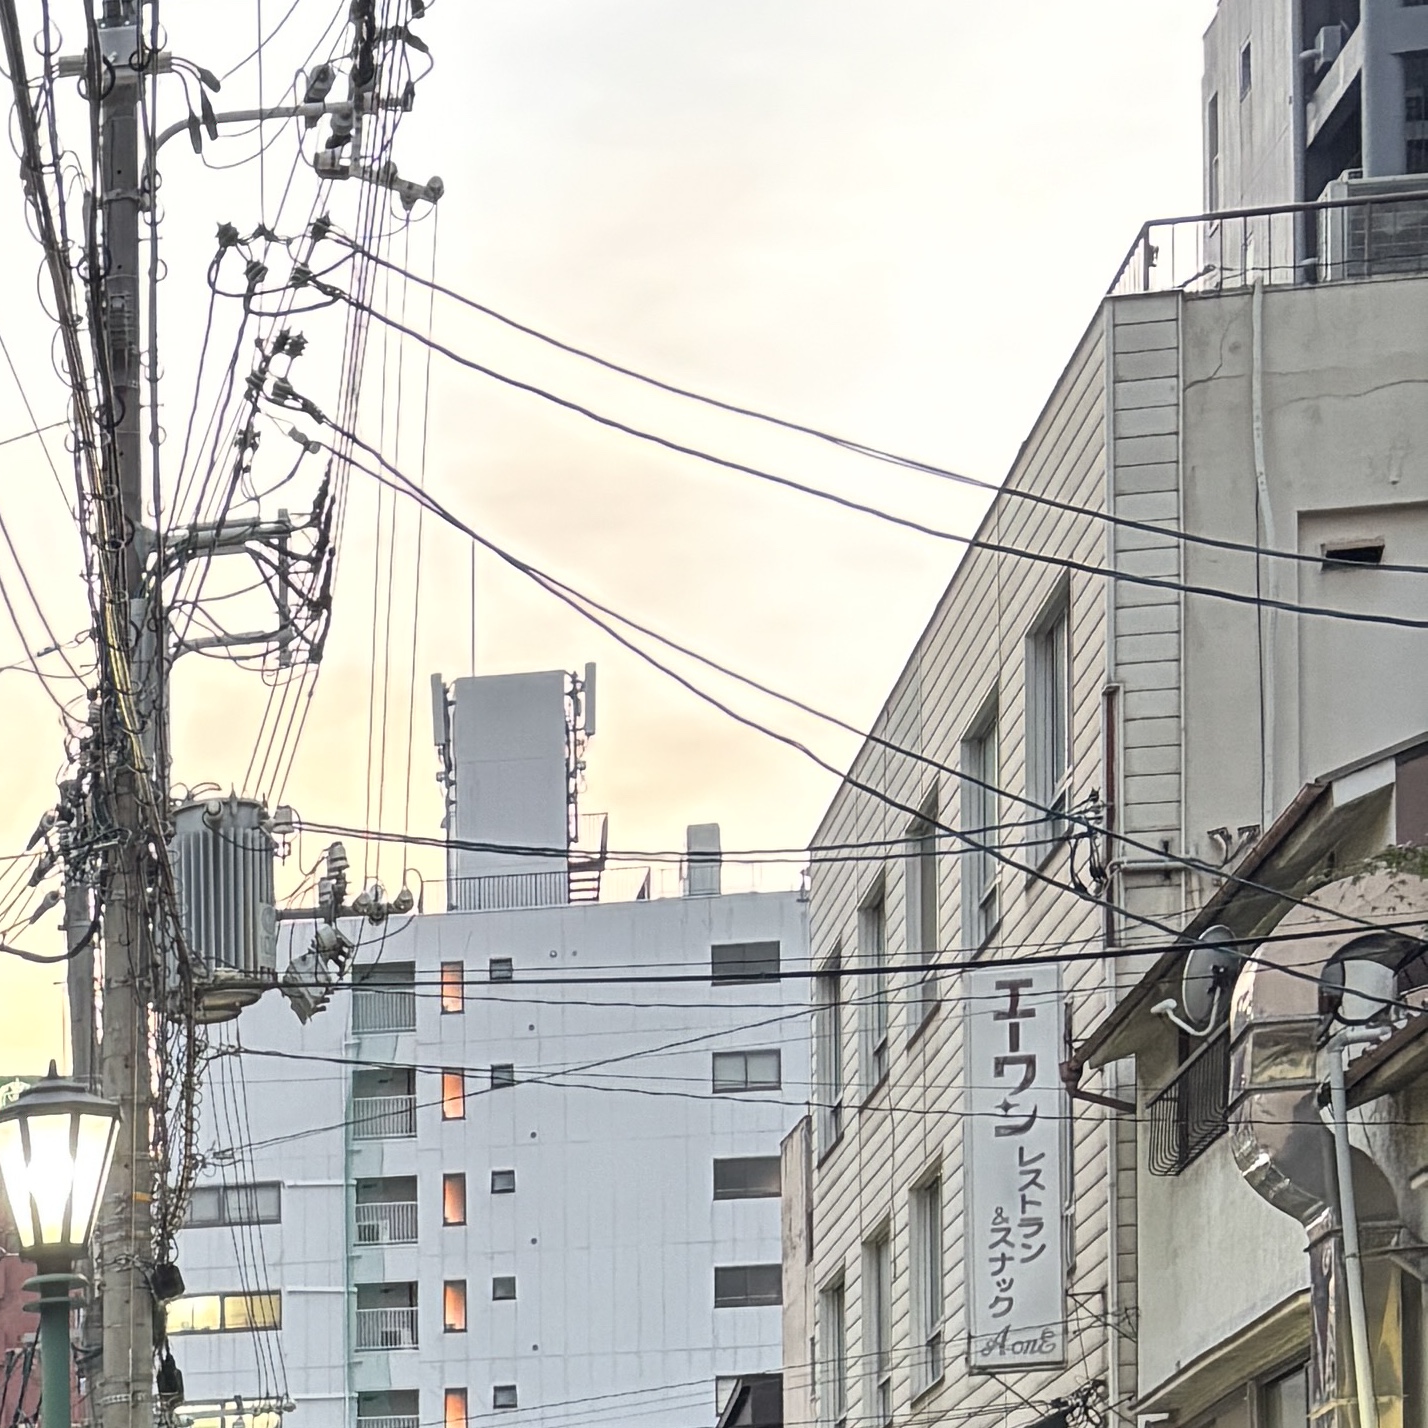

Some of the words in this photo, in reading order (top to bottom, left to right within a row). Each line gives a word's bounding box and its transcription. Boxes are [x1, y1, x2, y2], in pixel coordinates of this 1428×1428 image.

[993, 978, 1038, 1137] エーワン
[988, 1206, 1015, 1318] &スナック
[1017, 1146, 1046, 1264] レストラン
